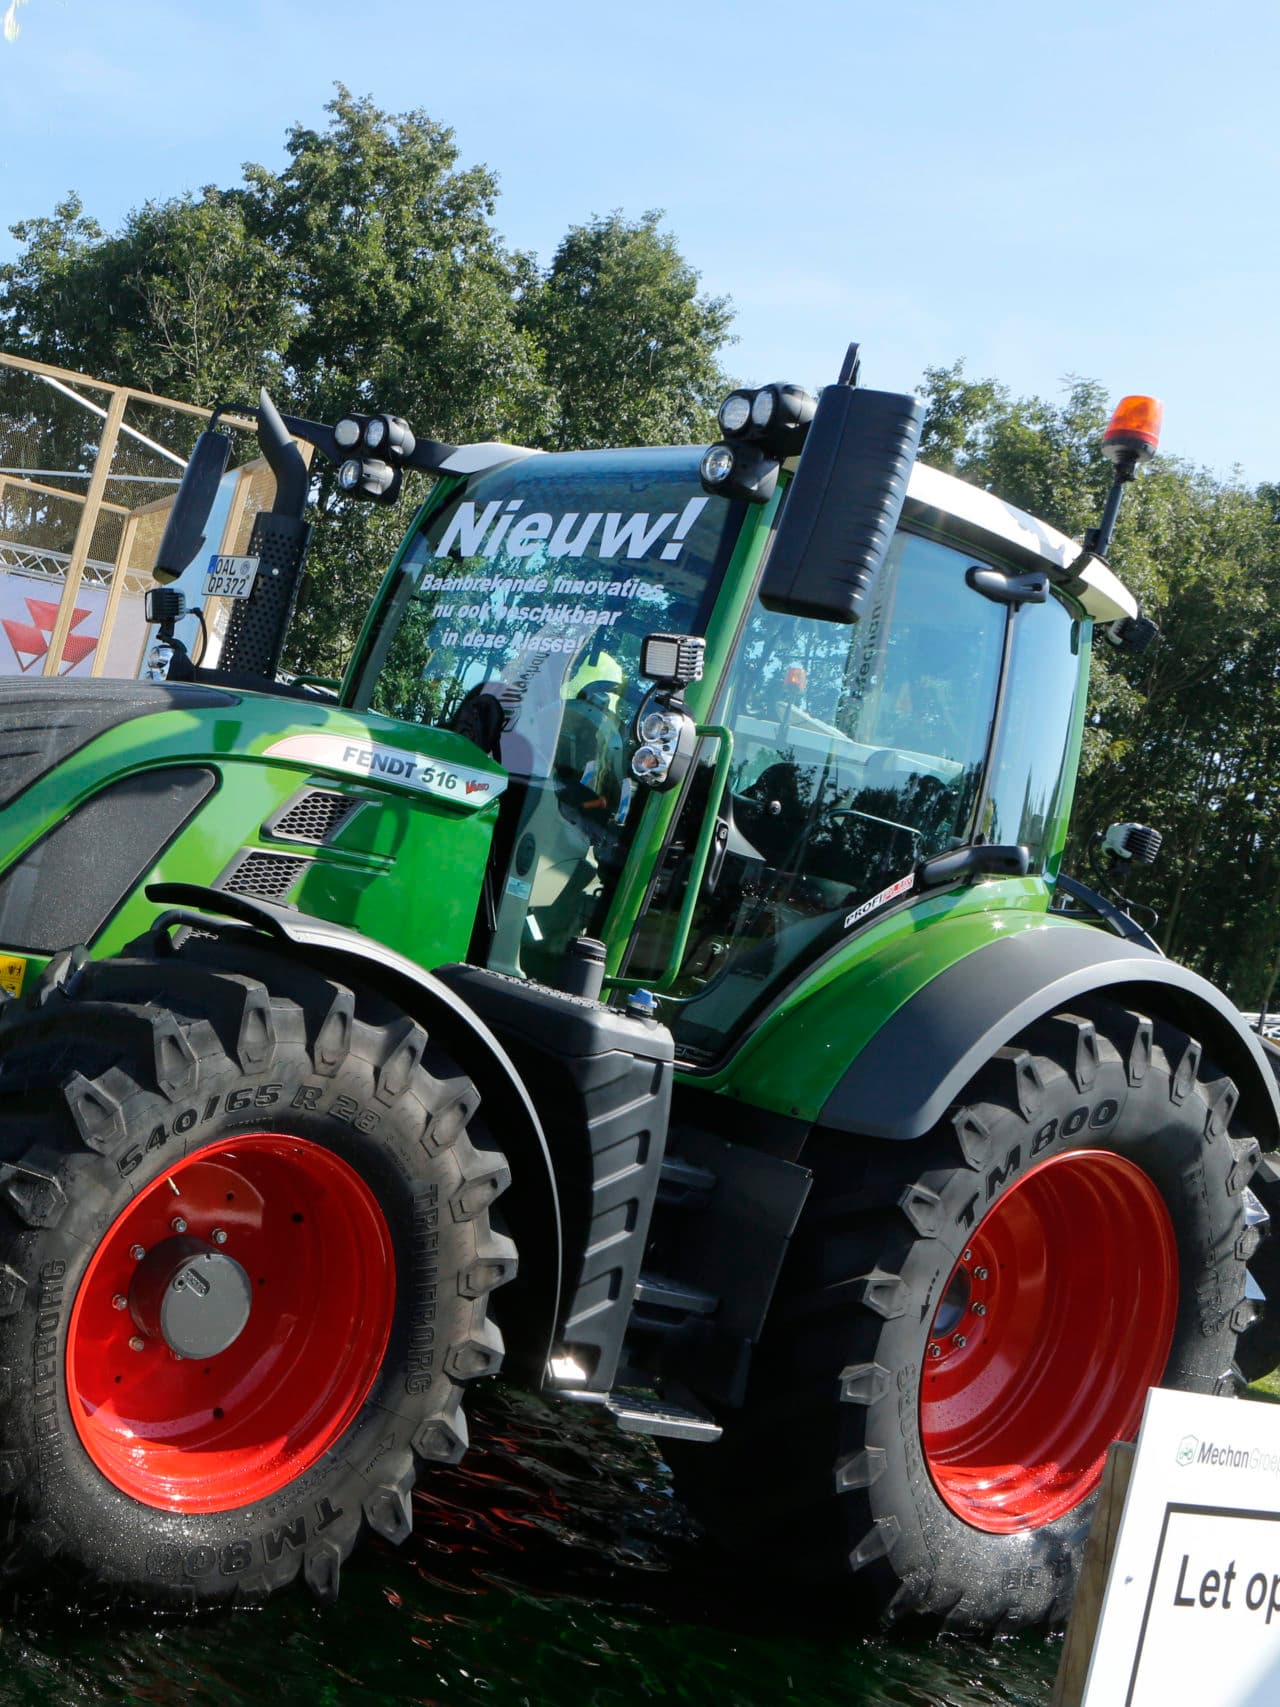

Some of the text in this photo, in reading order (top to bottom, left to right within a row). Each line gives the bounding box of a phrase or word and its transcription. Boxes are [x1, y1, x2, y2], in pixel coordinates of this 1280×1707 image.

[434, 497, 710, 561] Nieuw!
[215, 559, 236, 575] OAL
[420, 573, 549, 593] Baanbrekende
[432, 601, 622, 626] nu ook beschikbaar
[440, 628, 458, 645] in
[462, 630, 506, 649] deze
[343, 746, 417, 779] FENDT
[422, 767, 458, 790] 516
[116, 1083, 381, 1179] 540/65 R 28
[1173, 1554, 1237, 1609] Let
